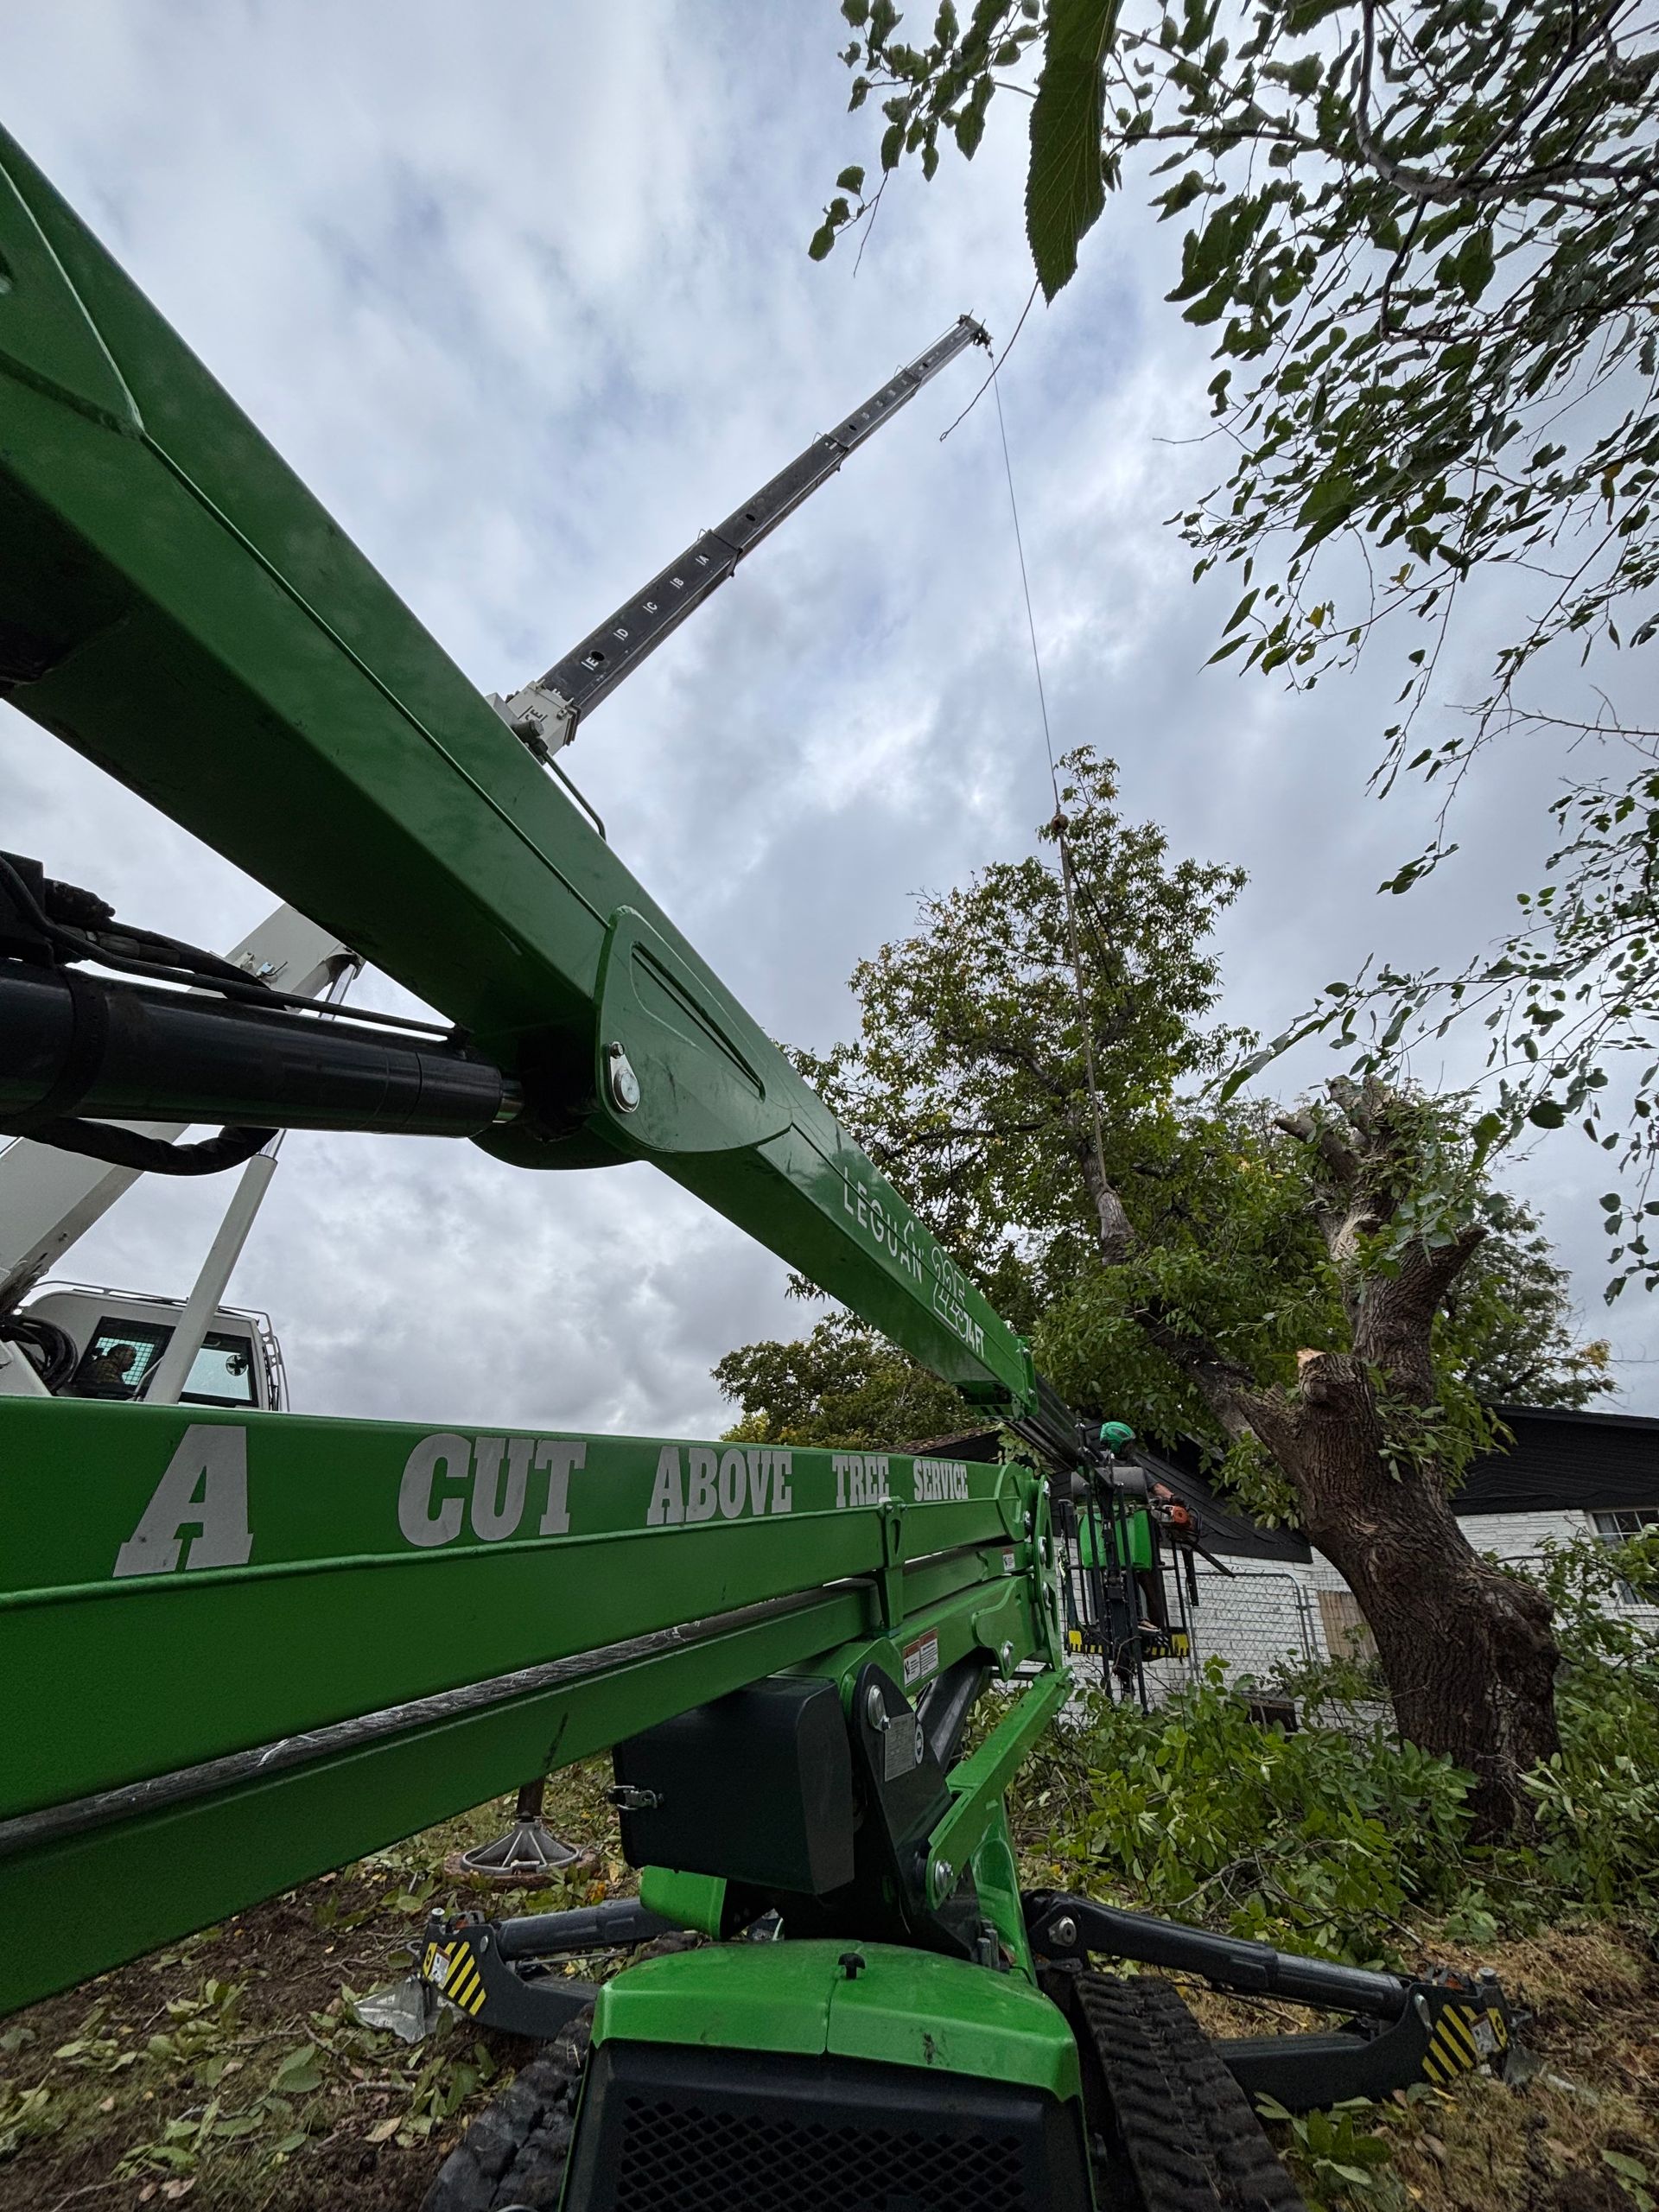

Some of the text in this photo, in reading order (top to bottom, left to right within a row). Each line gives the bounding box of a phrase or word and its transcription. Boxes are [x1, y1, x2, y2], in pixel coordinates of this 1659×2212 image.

[843, 1166, 923, 1285] LEGUAN
[112, 1423, 969, 1578] A CUT ABOVE TREE SERVICE
